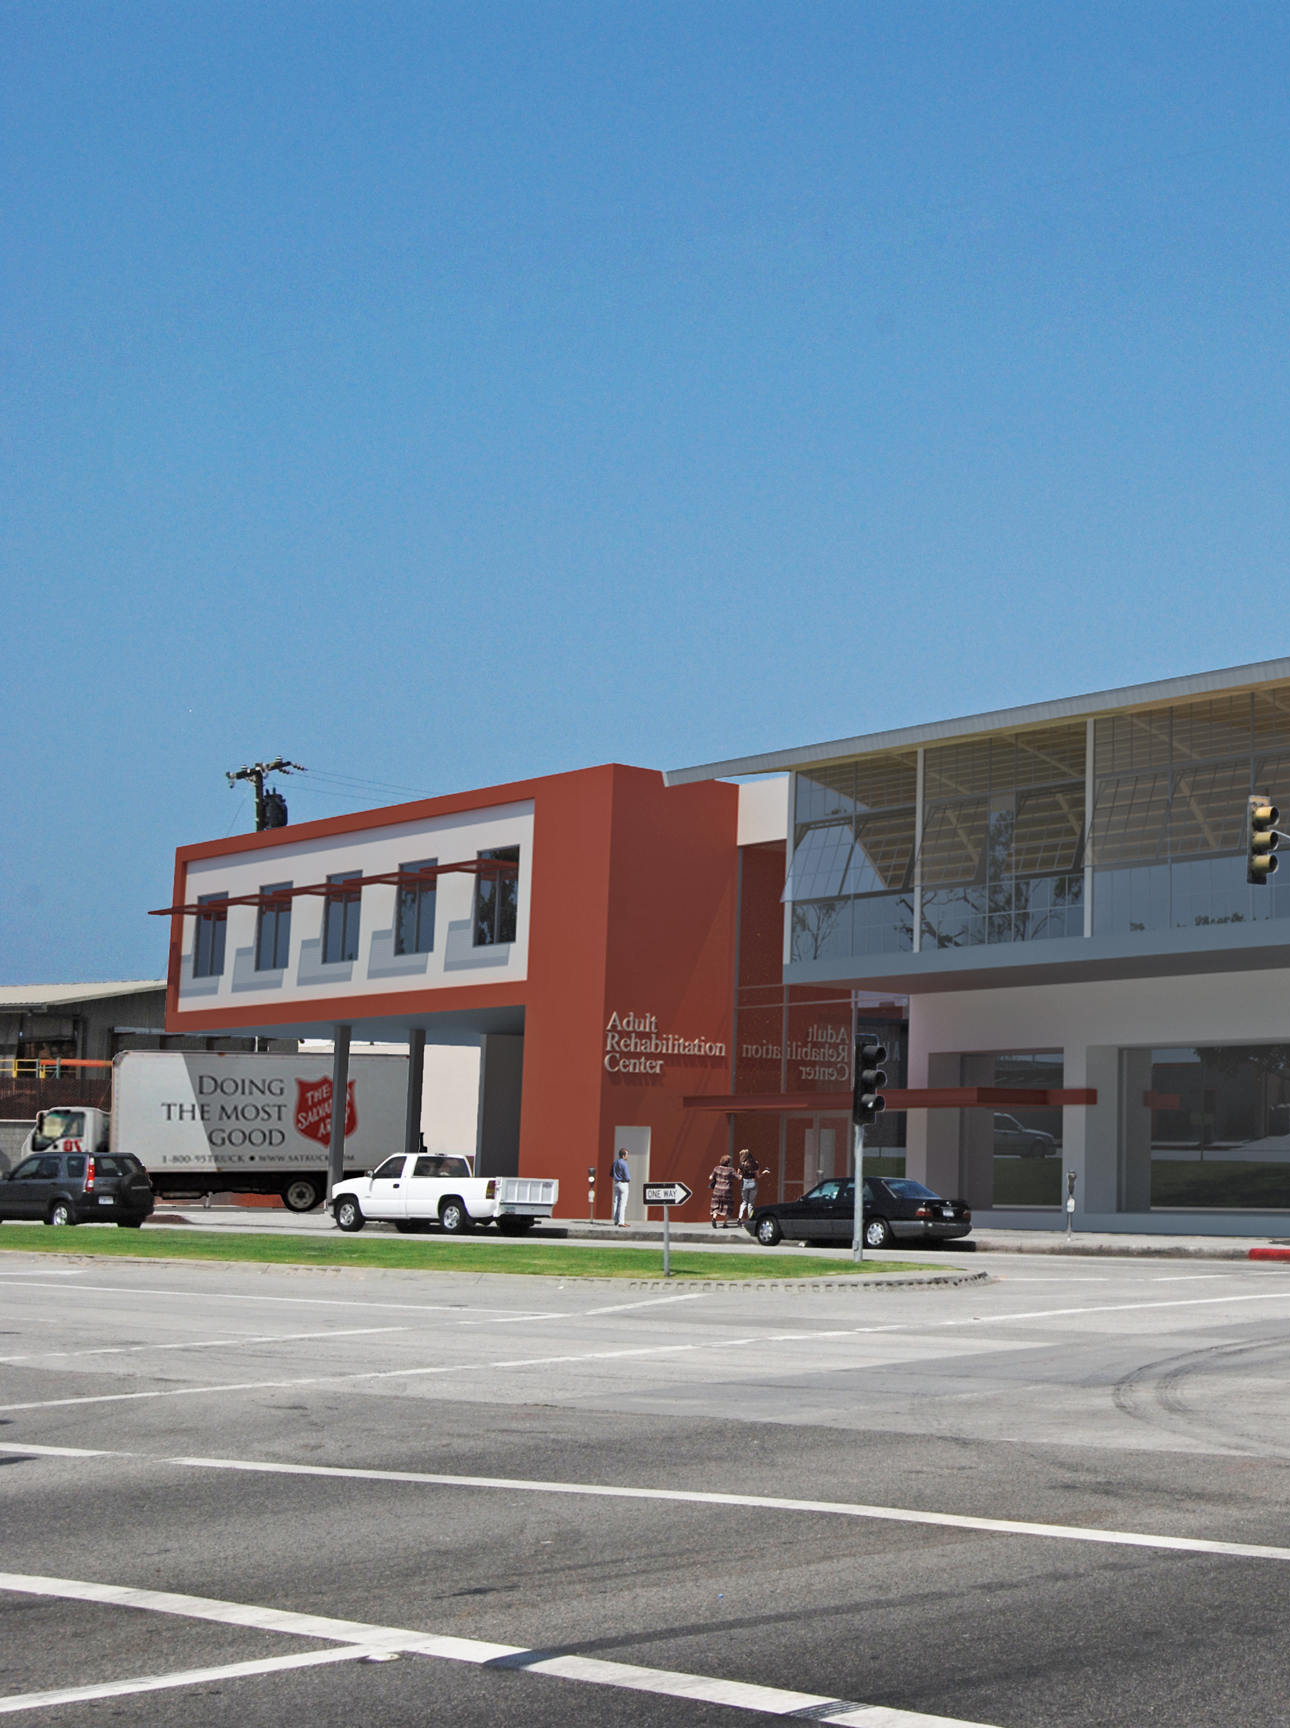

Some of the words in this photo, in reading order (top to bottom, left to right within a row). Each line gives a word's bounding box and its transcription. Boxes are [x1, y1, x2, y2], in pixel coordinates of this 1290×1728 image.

[606, 1011, 657, 1032] Adult
[605, 1032, 726, 1056] Rehabilitation
[604, 1053, 664, 1074] Center
[199, 1075, 285, 1097] DOING
[306, 1084, 331, 1106] THE
[161, 1103, 211, 1122] THE
[218, 1103, 287, 1122] MOST
[208, 1128, 286, 1148] GOOD
[648, 1190, 661, 1198] ONE
[664, 1190, 677, 1198] WAY
